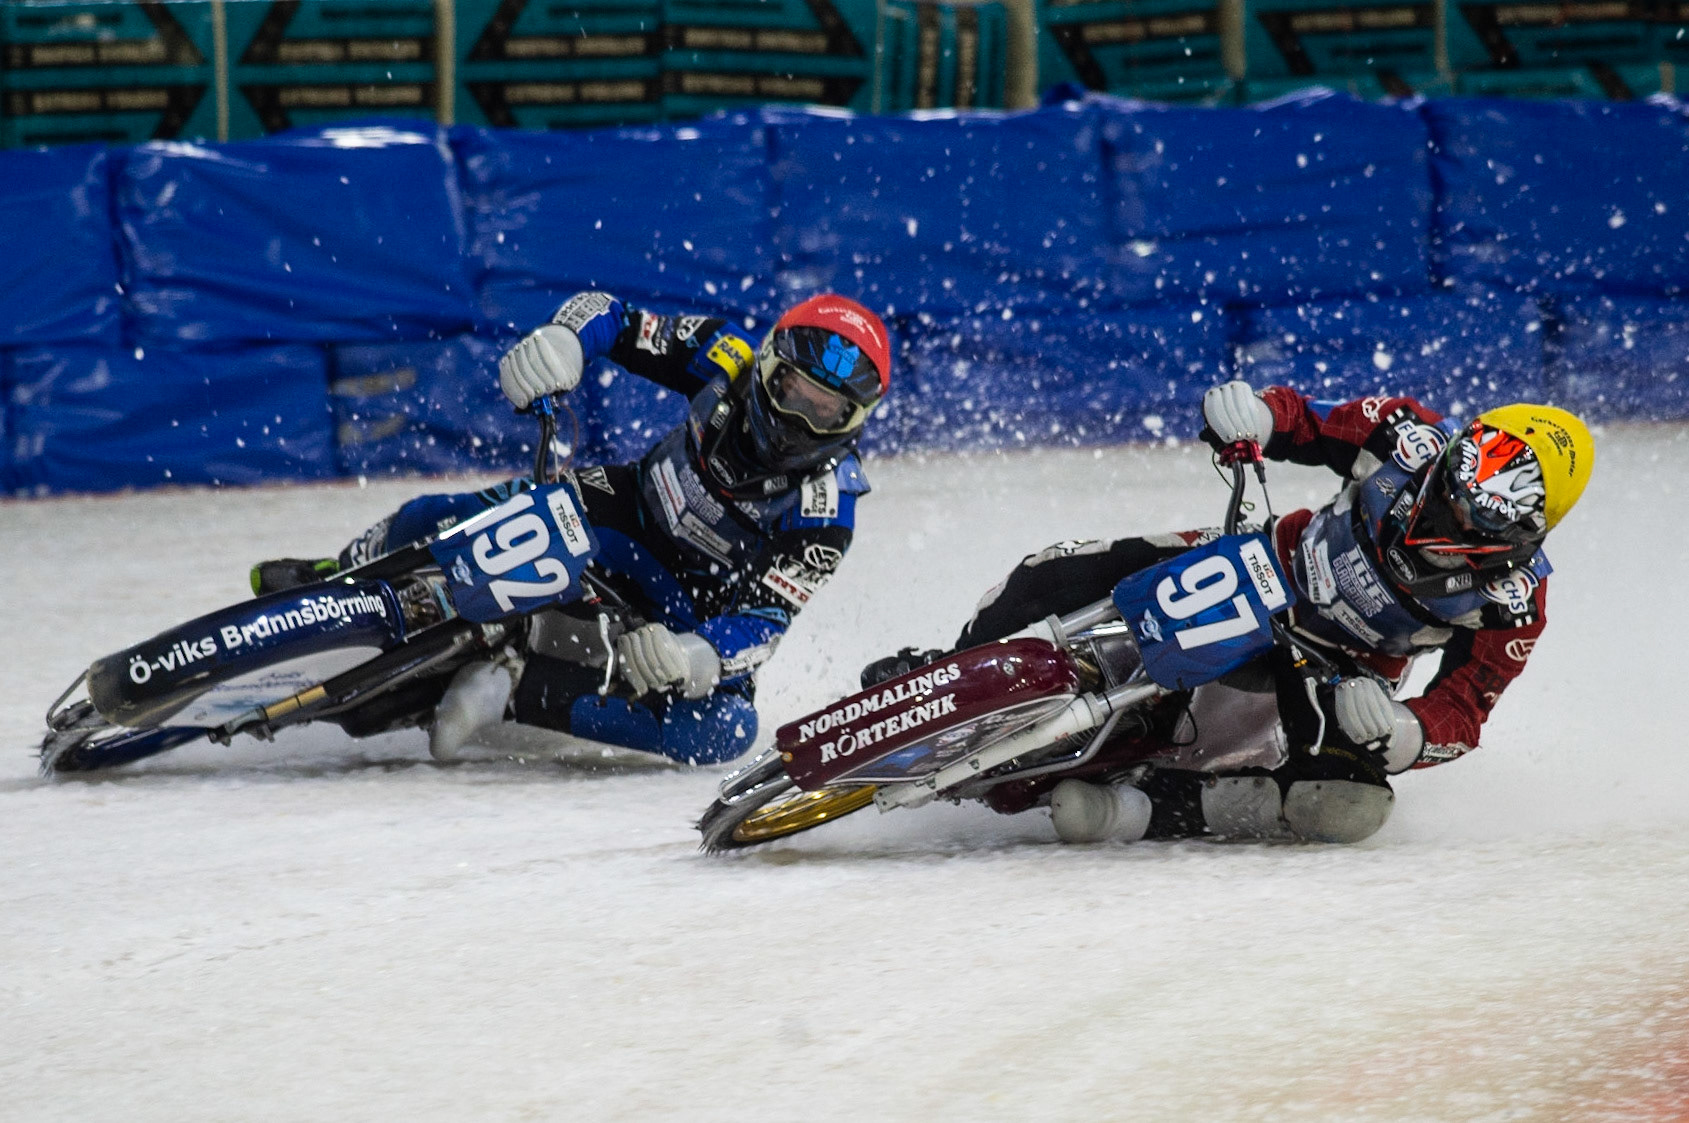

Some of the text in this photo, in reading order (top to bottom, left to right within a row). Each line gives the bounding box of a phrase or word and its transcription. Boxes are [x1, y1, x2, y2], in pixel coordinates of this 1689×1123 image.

[555, 503, 580, 544] TISSOT
[1475, 491, 1517, 522] Airoh
[465, 493, 571, 613] 192
[1248, 553, 1274, 596] TISSOT
[1156, 554, 1260, 651] 97
[1332, 555, 1375, 618] GLADIATORS
[1501, 580, 1526, 612] CHS
[129, 634, 218, 686] Ö-viks
[798, 663, 962, 744] NORDMALINGS
[820, 693, 958, 764] RÖRTEKNIK
